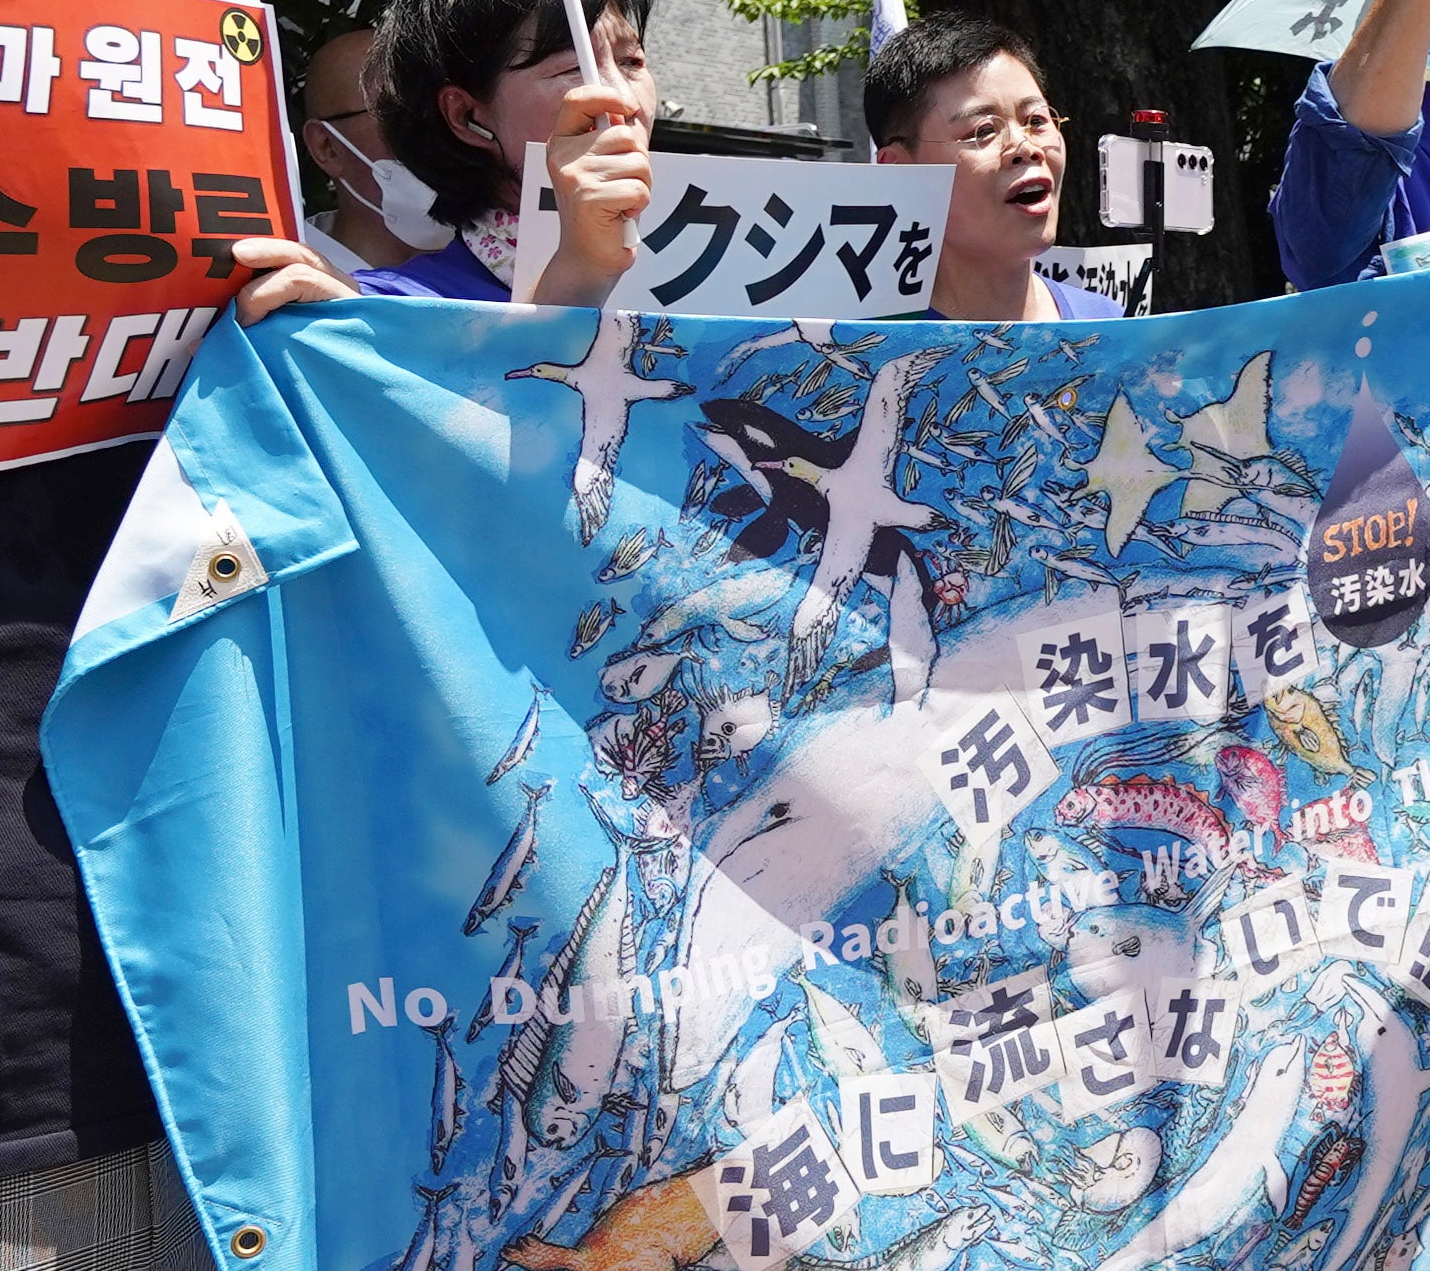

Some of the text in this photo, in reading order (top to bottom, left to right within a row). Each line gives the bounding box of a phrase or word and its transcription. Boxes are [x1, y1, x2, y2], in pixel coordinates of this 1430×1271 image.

[78, 23, 246, 133] 원전
[538, 183, 934, 308] クシマを
[1322, 497, 1419, 564] STOP!
[1330, 558, 1427, 616] 汚染水
[939, 601, 1310, 826] 汚染水を
[347, 976, 448, 1036] No
[489, 943, 776, 1028] Dumping
[799, 866, 1119, 972] Radioactive
[1141, 815, 1270, 888] Water
[1291, 786, 1374, 842] into
